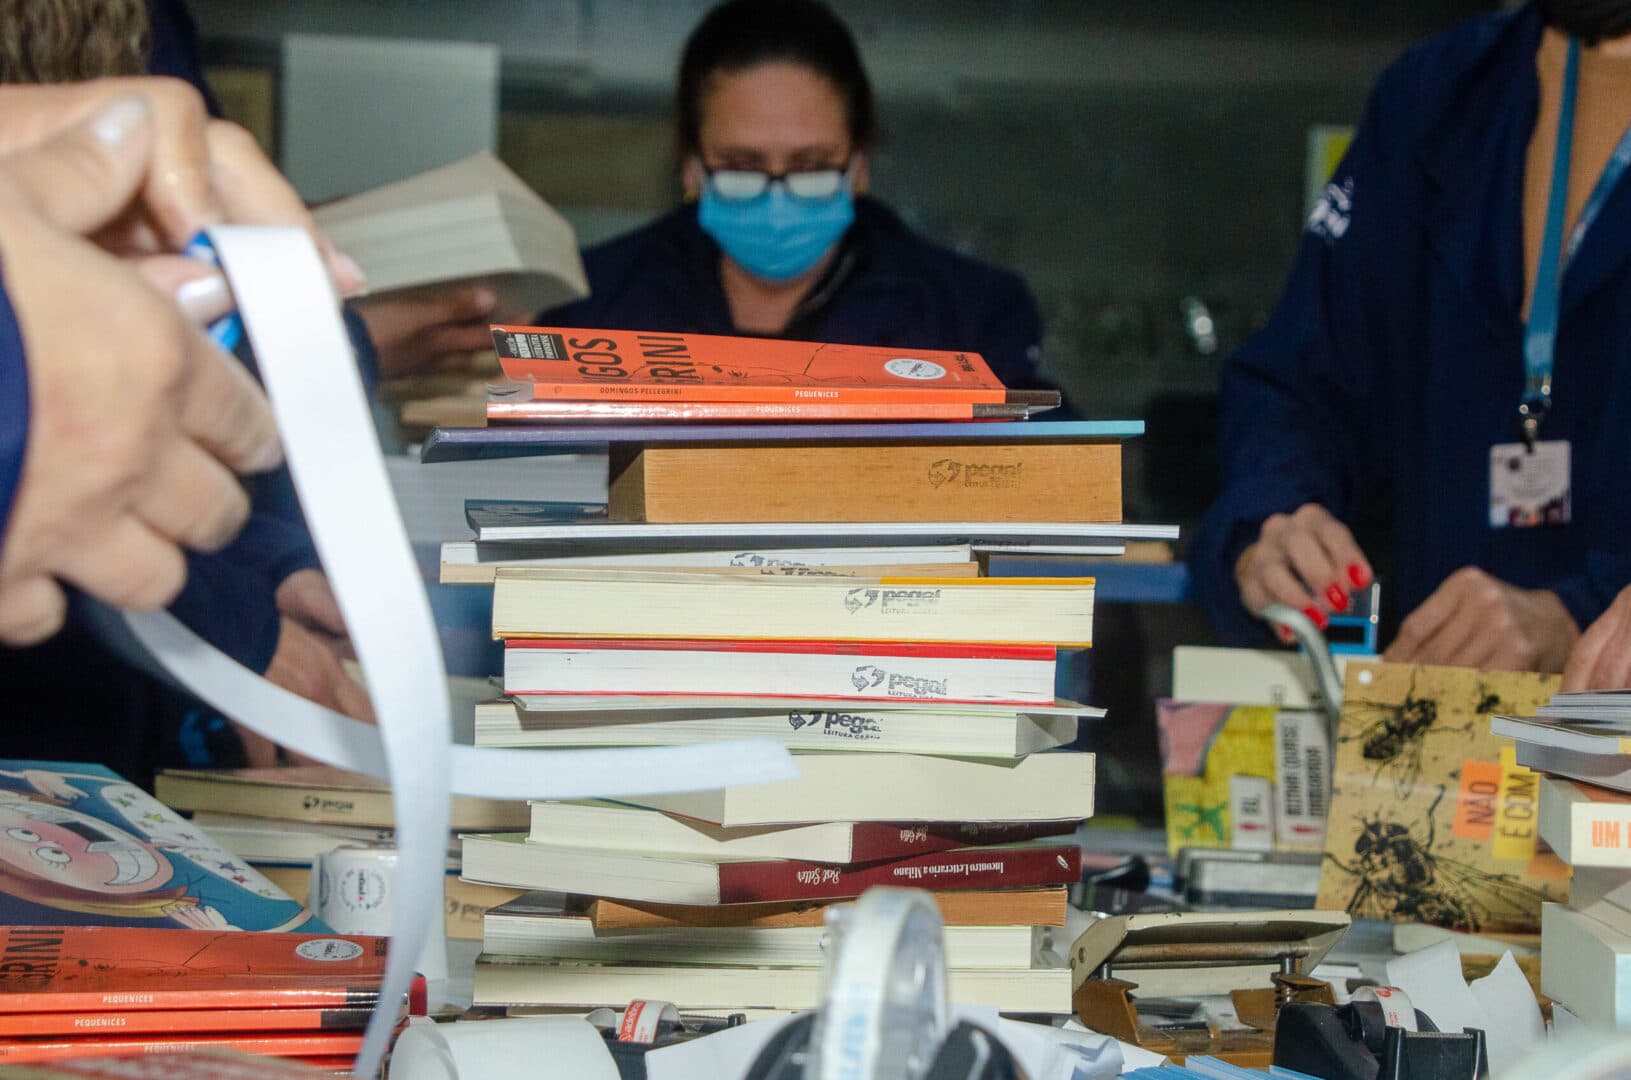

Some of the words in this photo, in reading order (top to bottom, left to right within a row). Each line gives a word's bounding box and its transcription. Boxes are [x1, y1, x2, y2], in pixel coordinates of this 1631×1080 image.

[567, 336, 629, 379] GOS
[637, 335, 701, 382] RINI
[600, 387, 639, 395] DOMINGOS
[640, 387, 682, 395] PELLEGRINI
[795, 390, 840, 398] PEQUENICES
[823, 728, 853, 738] LEITURA
[1463, 780, 1498, 825] NÃO
[1591, 820, 1620, 849] UM
[894, 866, 923, 879] Milano
[922, 866, 929, 874] a
[929, 862, 969, 877] Letterario
[970, 862, 1004, 874] Incontro
[797, 870, 820, 885] Seller
[824, 868, 840, 885] Best
[102, 995, 154, 1004] PEQUENICES
[74, 1018, 126, 1027] PEQUENICES
